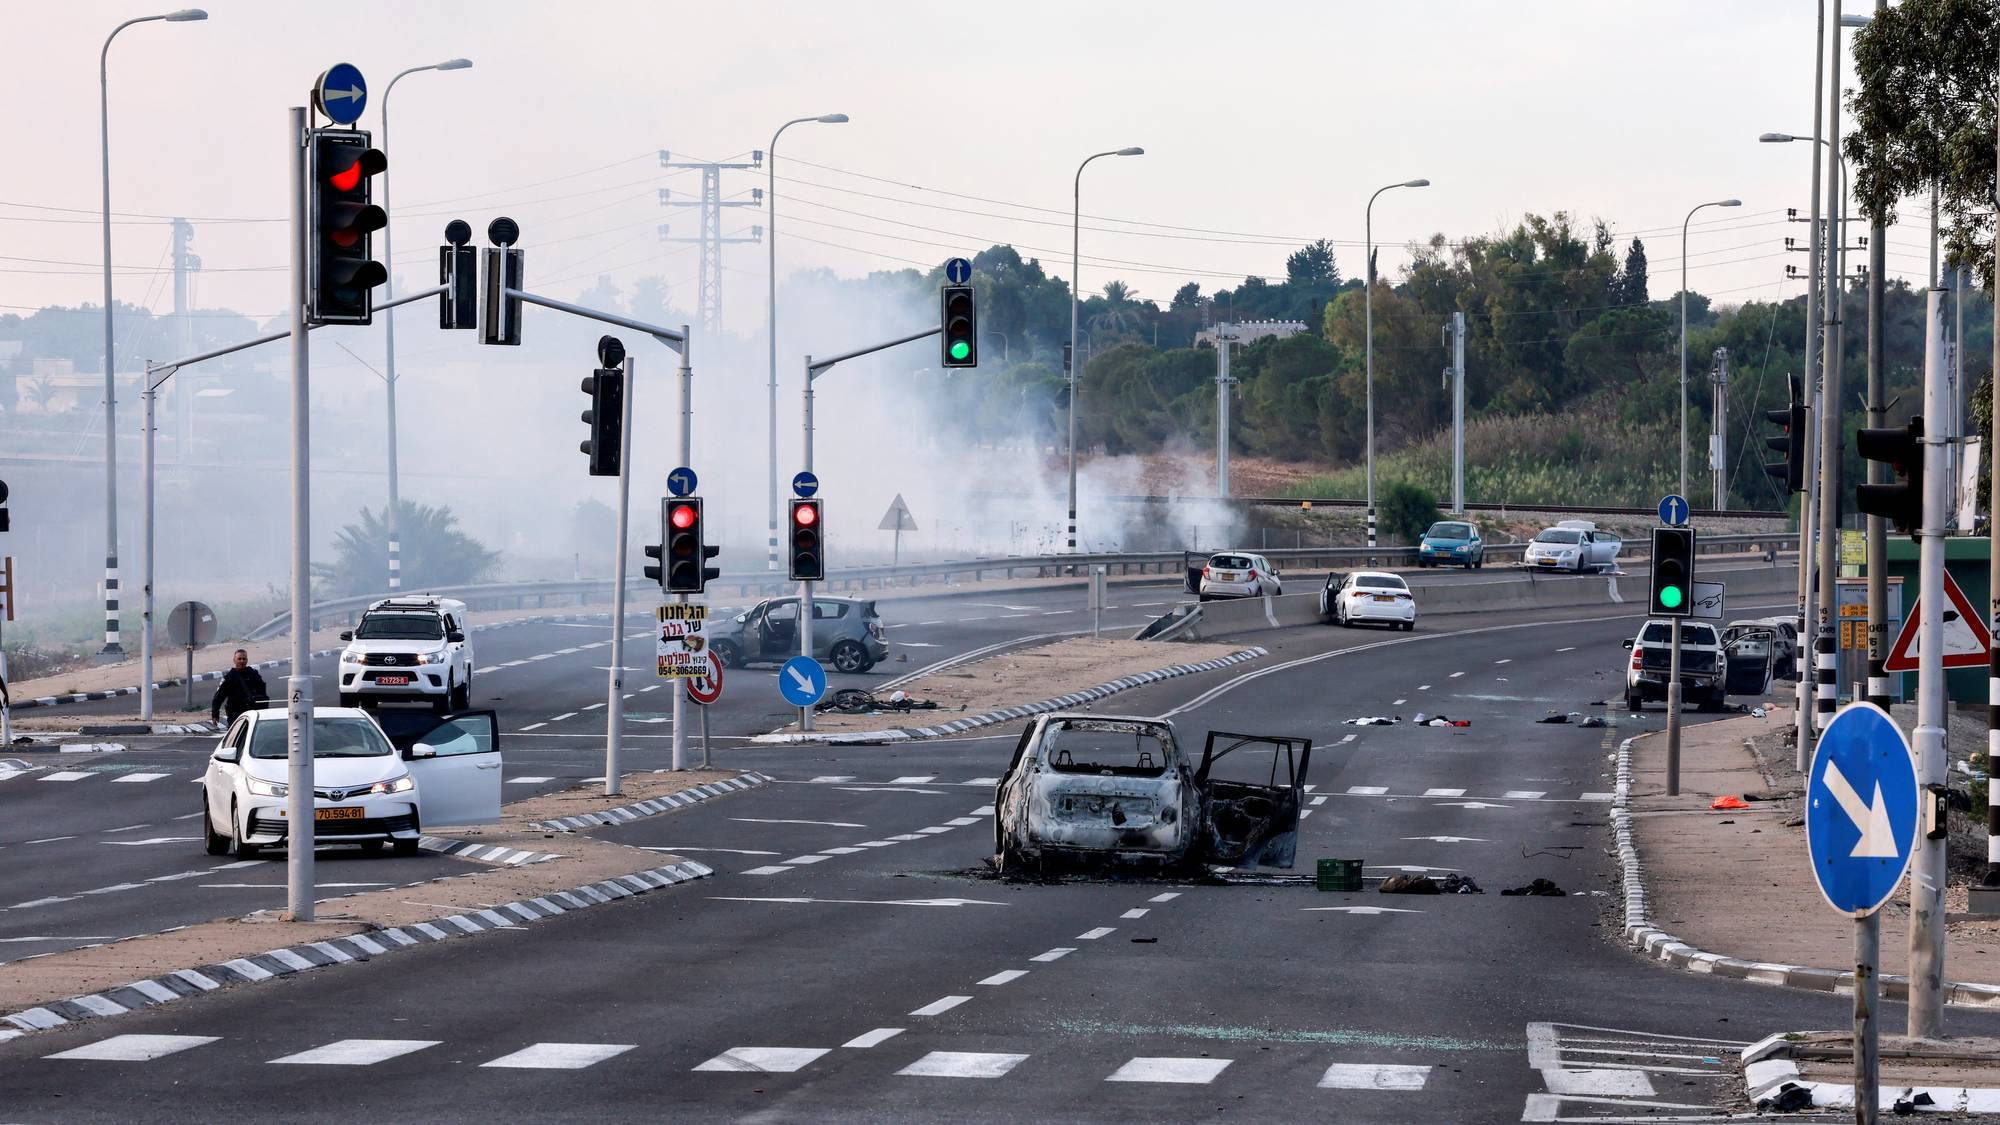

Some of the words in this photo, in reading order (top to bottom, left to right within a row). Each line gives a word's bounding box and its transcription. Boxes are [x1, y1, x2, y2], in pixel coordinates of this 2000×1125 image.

[660, 603, 704, 622] הג'חנון
[662, 622, 684, 637] גלה
[685, 620, 701, 633] של
[658, 651, 690, 666] מפלסים
[1870, 649, 1878, 657] 2
[692, 656, 707, 665] קיבוץ
